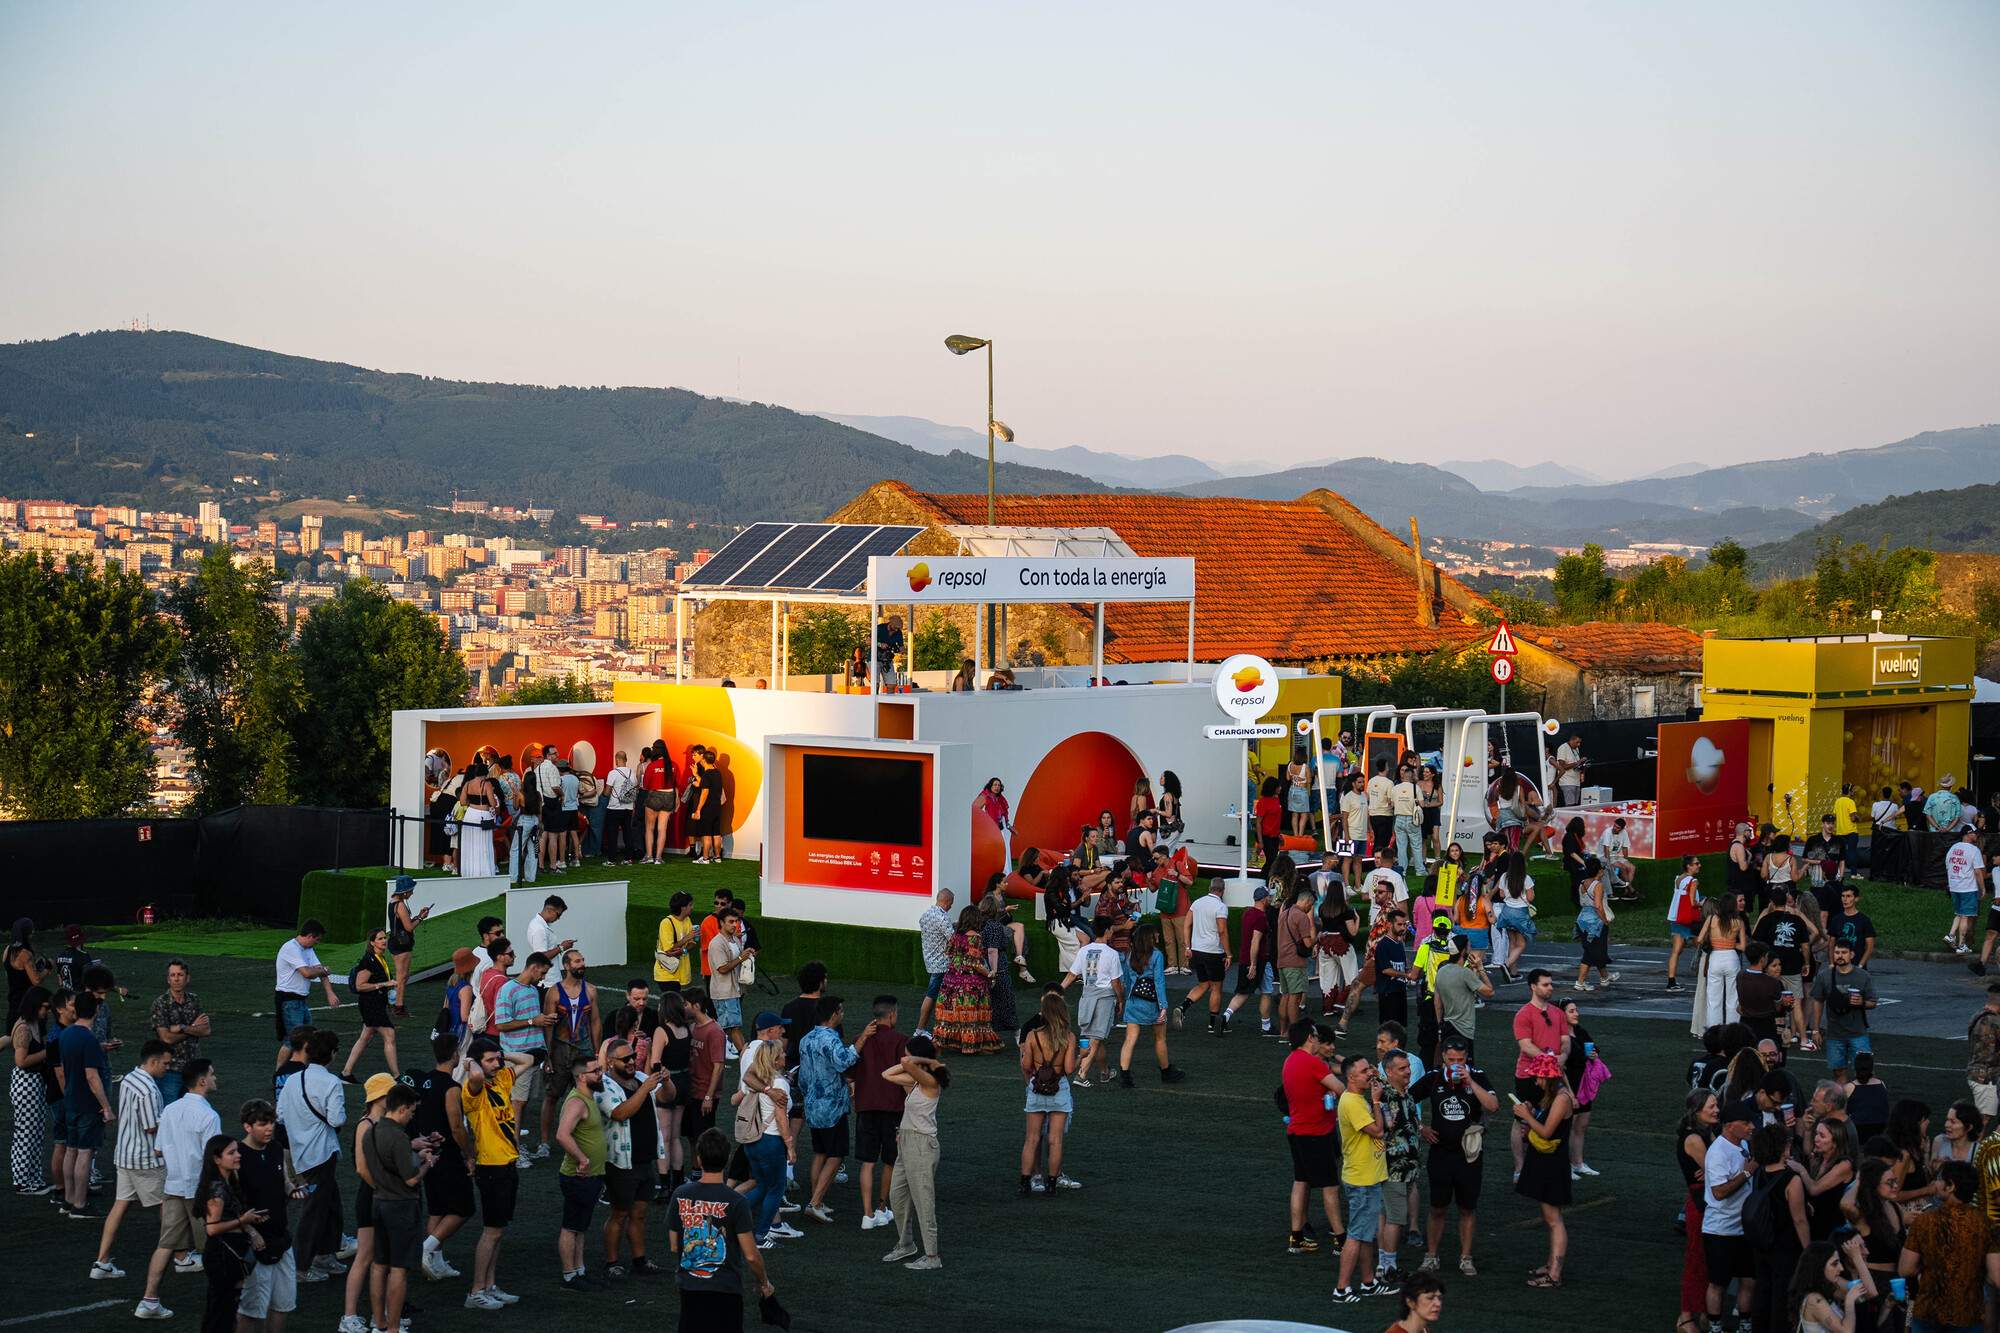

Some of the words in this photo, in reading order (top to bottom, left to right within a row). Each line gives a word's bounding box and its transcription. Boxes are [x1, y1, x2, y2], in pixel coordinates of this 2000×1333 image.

[938, 568, 987, 589] repsol
[1019, 567, 1050, 586] Con
[1053, 568, 1090, 586] toda
[1093, 568, 1107, 586] la
[1111, 566, 1167, 590] energía
[1880, 652, 1920, 678] vueling
[1230, 696, 1266, 706] repsol
[1777, 713, 1805, 724] vueling
[1214, 728, 1255, 736] CHARGING
[1256, 727, 1281, 735] POINT
[1446, 832, 1474, 840] rpsol
